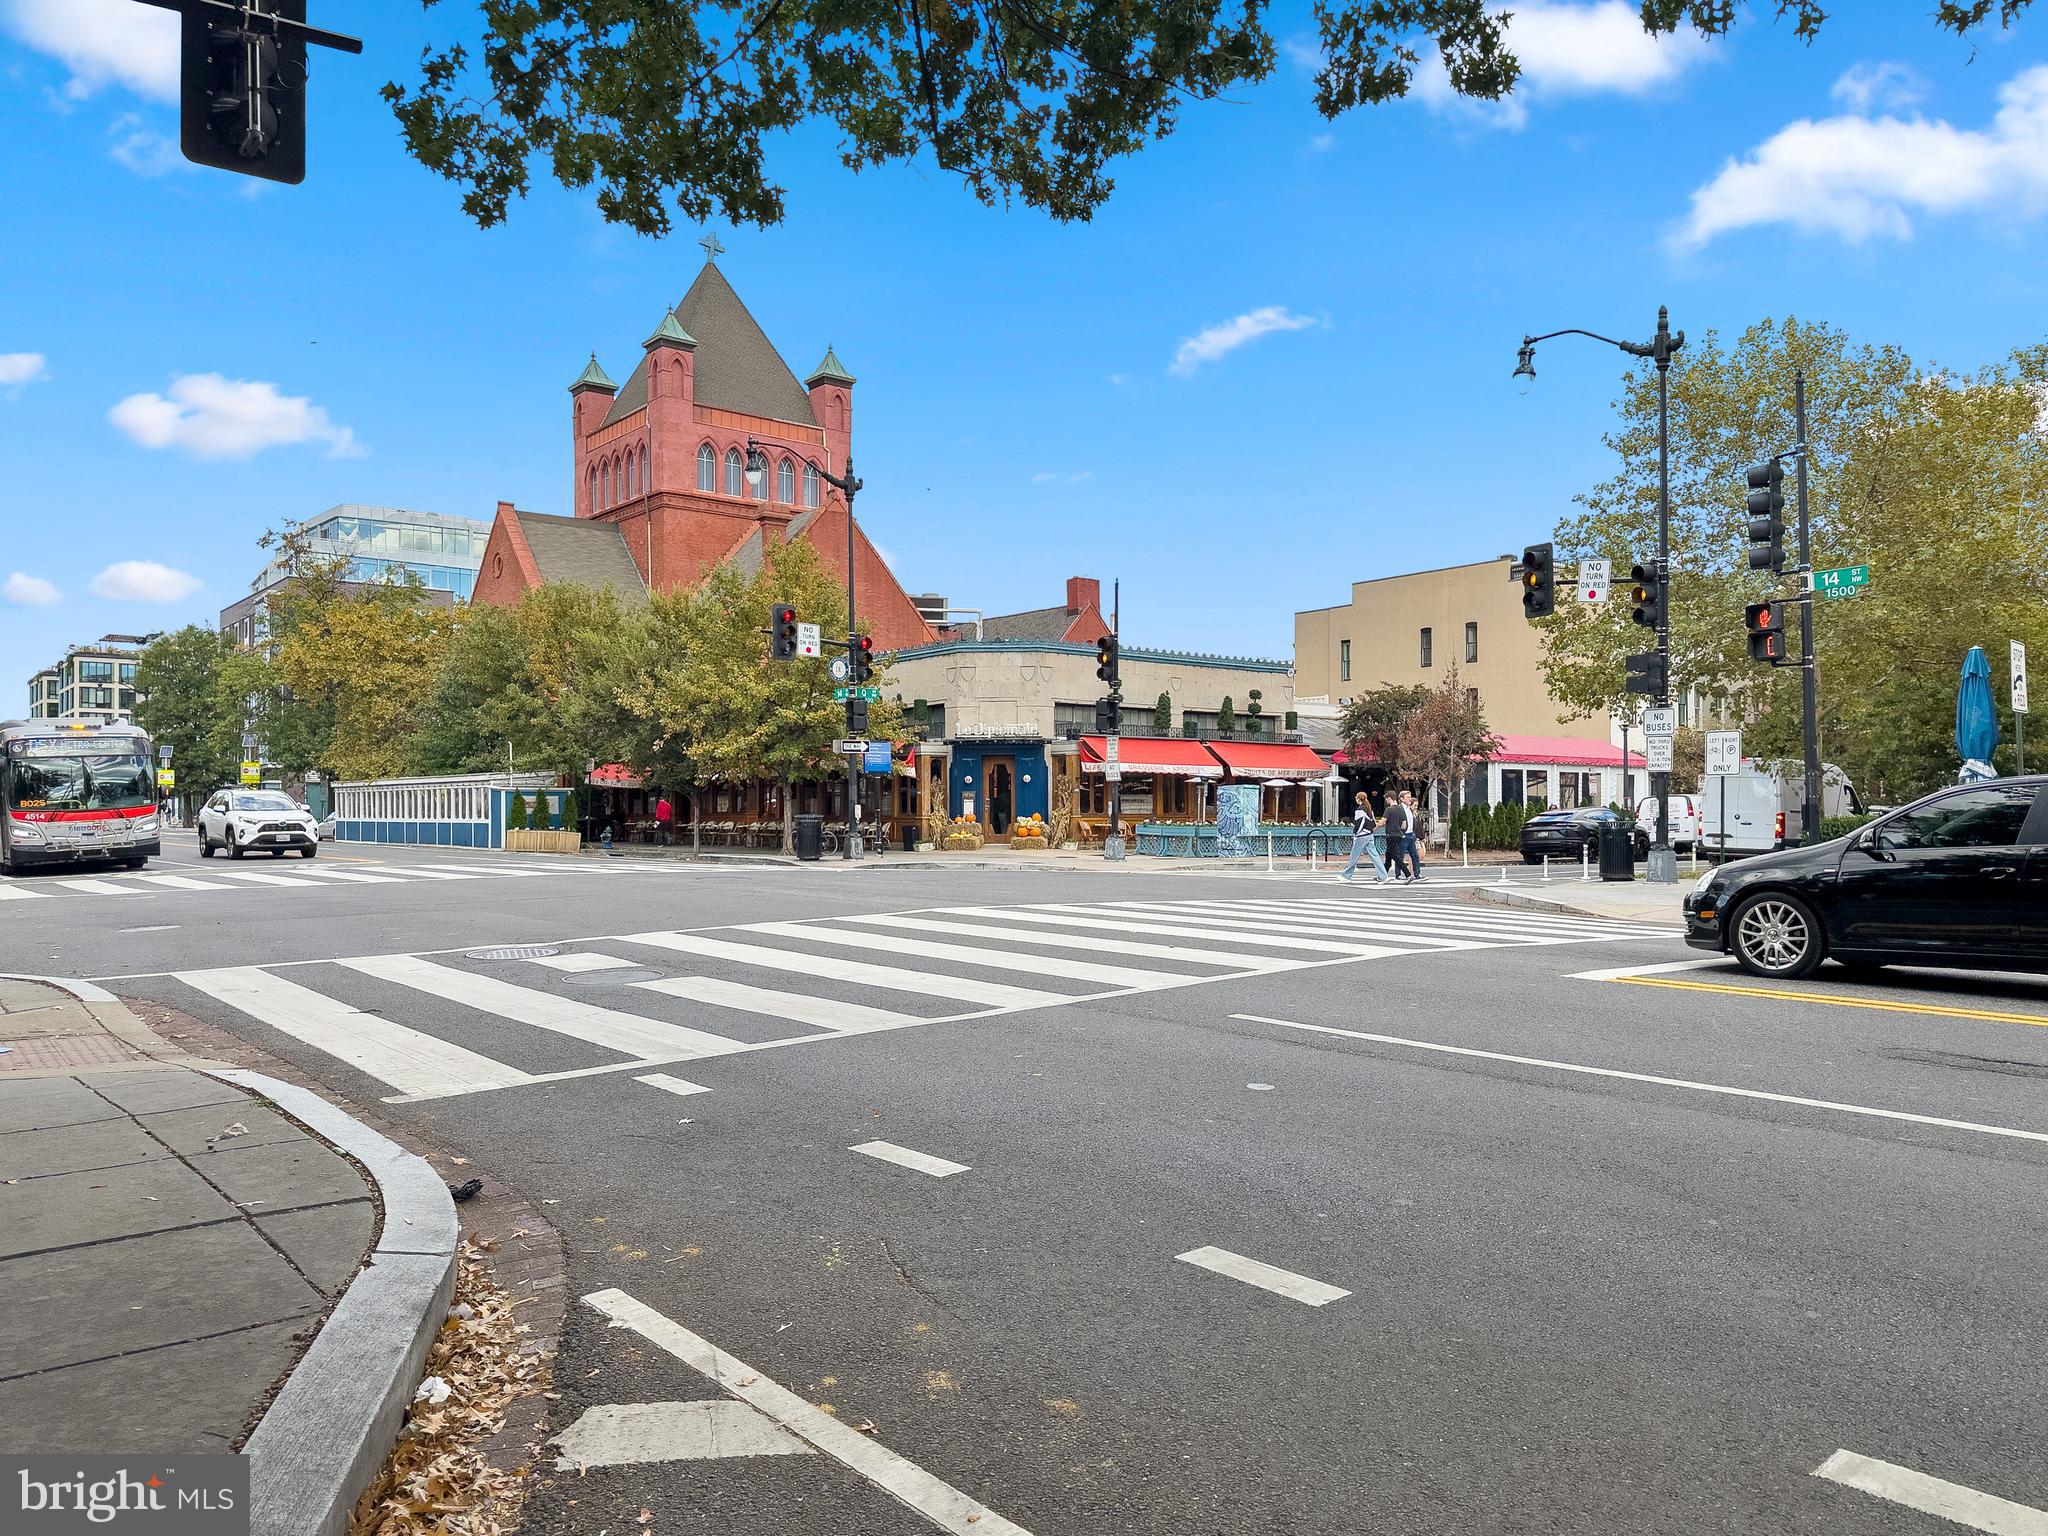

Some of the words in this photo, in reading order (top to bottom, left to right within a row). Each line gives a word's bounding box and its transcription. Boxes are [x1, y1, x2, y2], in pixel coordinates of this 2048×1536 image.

[1588, 562, 1602, 571] NO
[1821, 572, 1840, 587] 14
[1851, 568, 1862, 576] ST
[1851, 575, 1863, 583] NW
[1825, 586, 1856, 598] 1500
[803, 626, 814, 634] NO
[1653, 713, 1665, 721] NO
[1646, 723, 1672, 732] BUSES
[1712, 764, 1732, 772] ONLY
